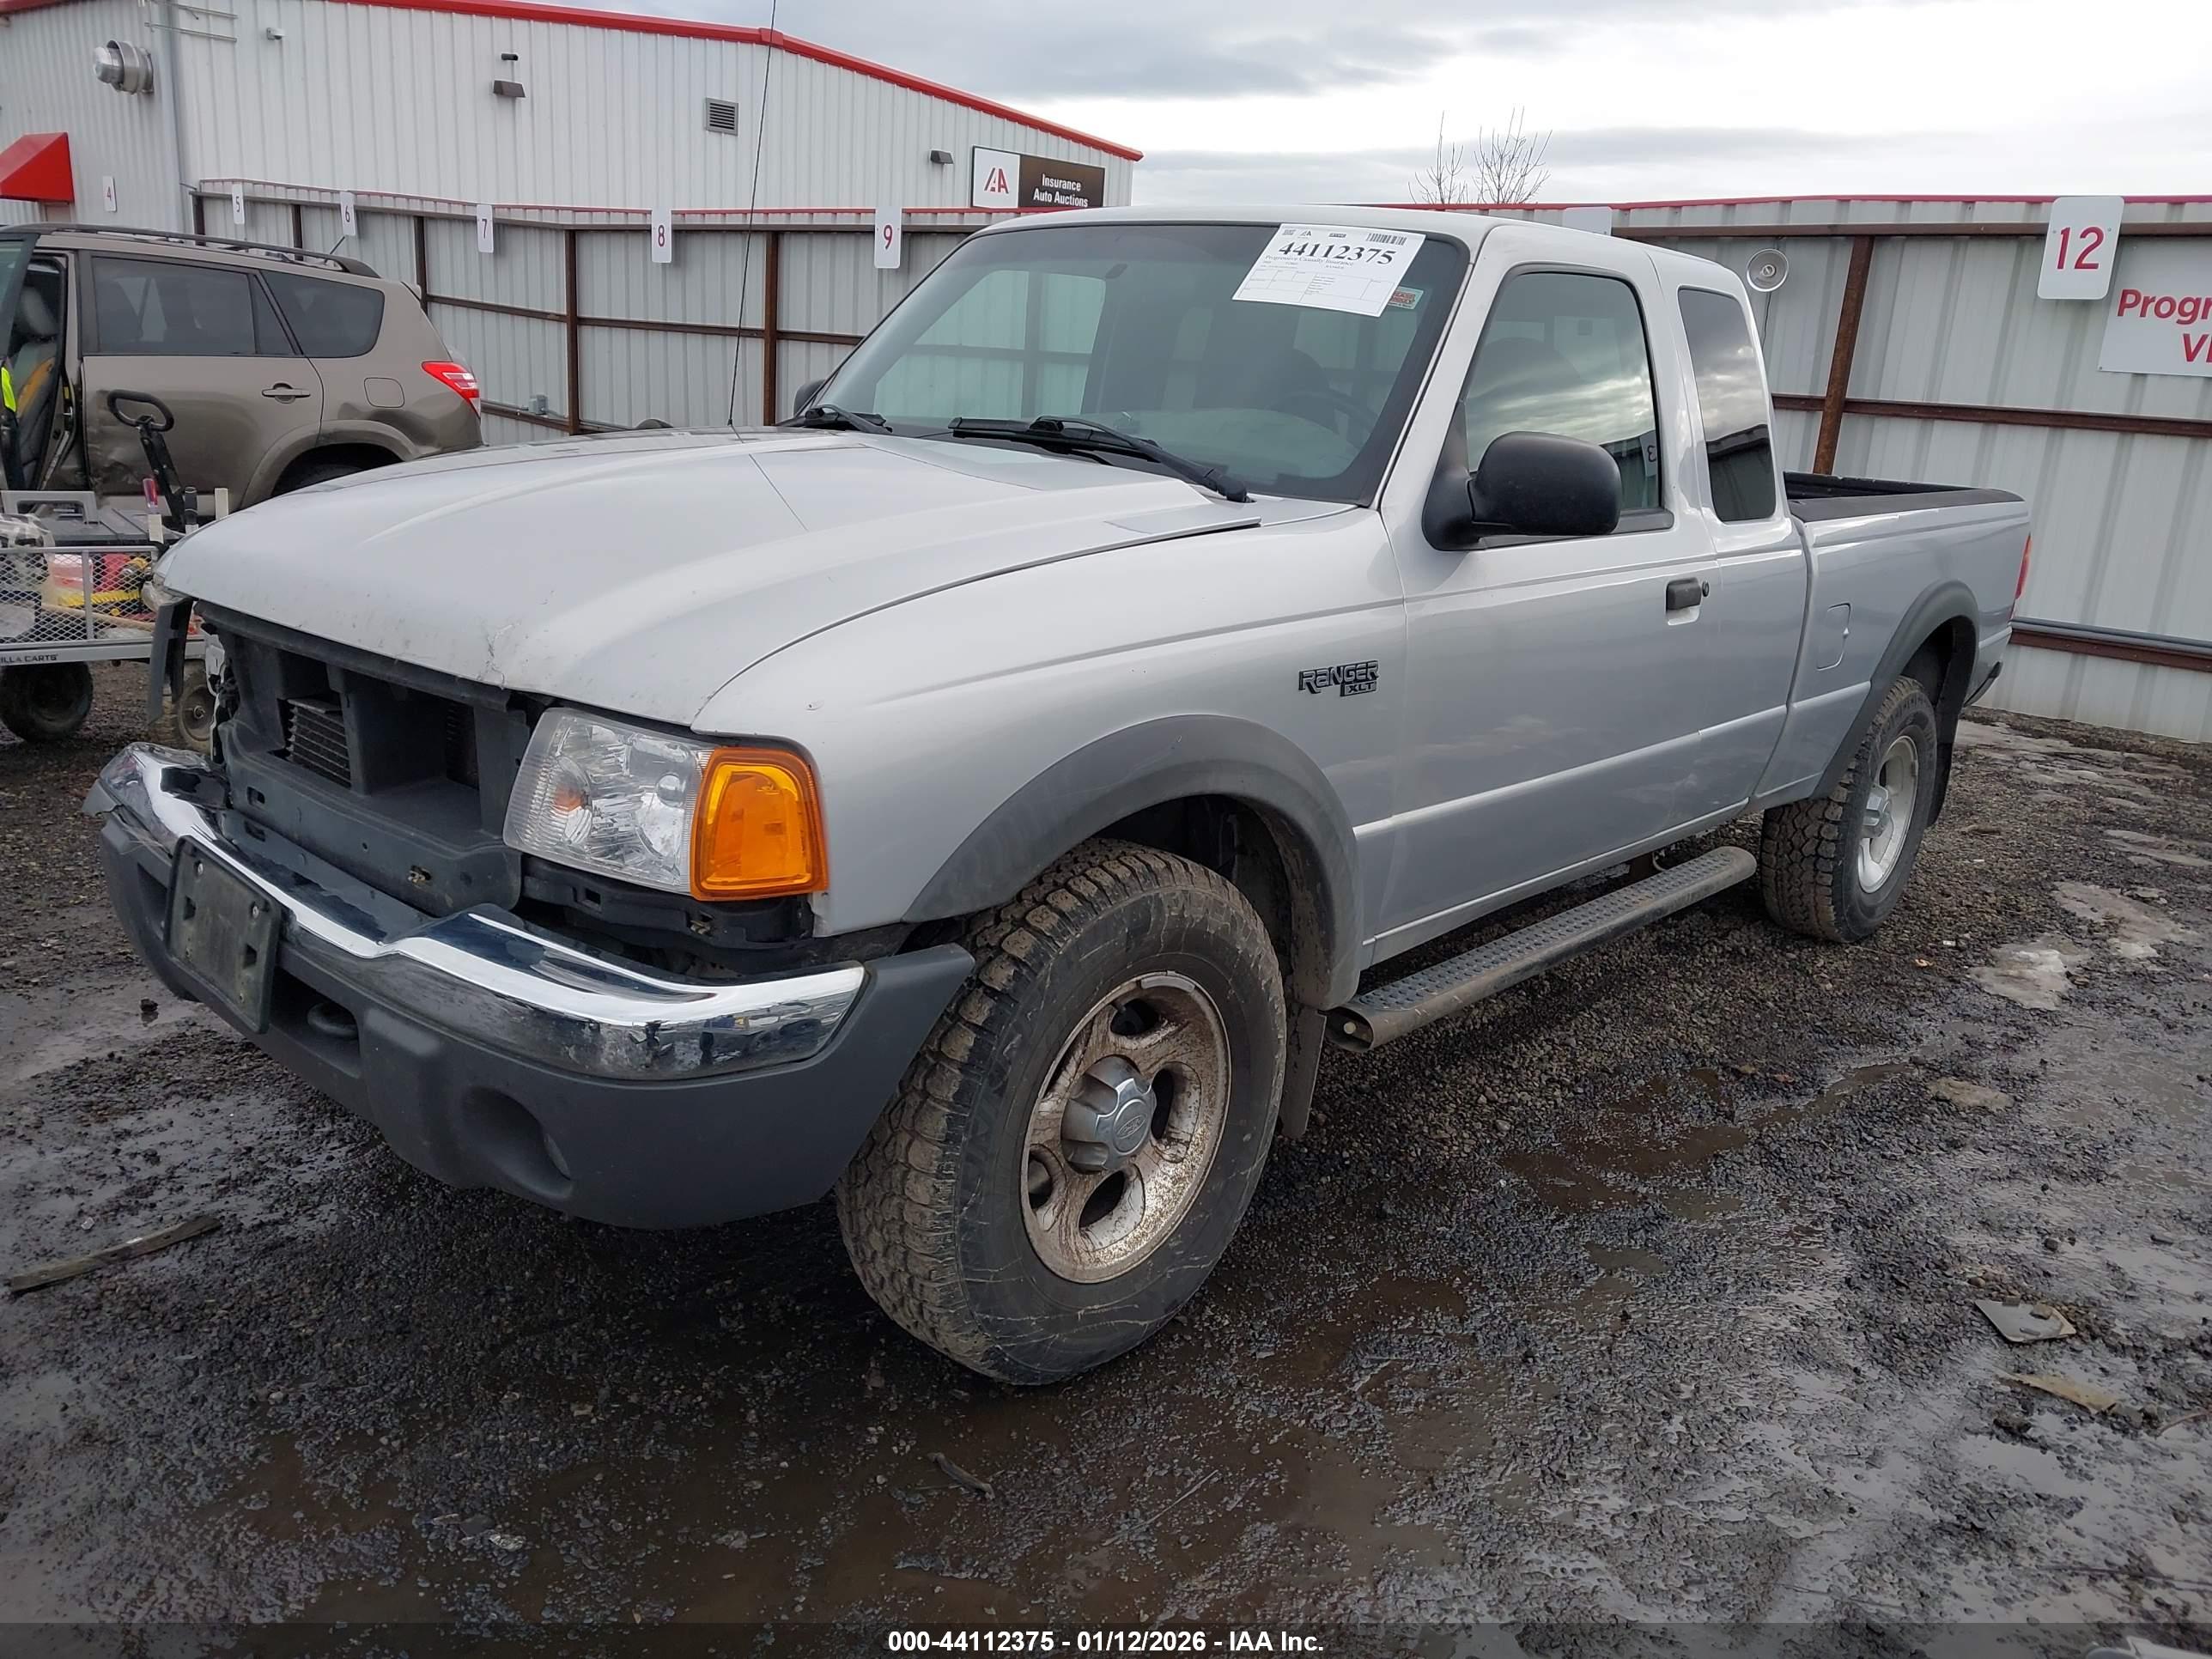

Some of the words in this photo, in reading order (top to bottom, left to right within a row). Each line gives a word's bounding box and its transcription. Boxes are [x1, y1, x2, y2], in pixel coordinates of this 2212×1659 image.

[1042, 173, 1082, 191] Insurance
[235, 196, 240, 213] 5
[1033, 188, 1053, 203] Auto
[1054, 191, 1089, 208] Auctions
[344, 205, 350, 223] 6
[482, 218, 488, 239] 7
[658, 225, 665, 247] 8
[883, 225, 893, 250] 9
[1278, 241, 1396, 265] 44112375
[2057, 226, 2105, 270] 12
[2117, 289, 2212, 325] Progr
[1345, 681, 1376, 695] XLT
